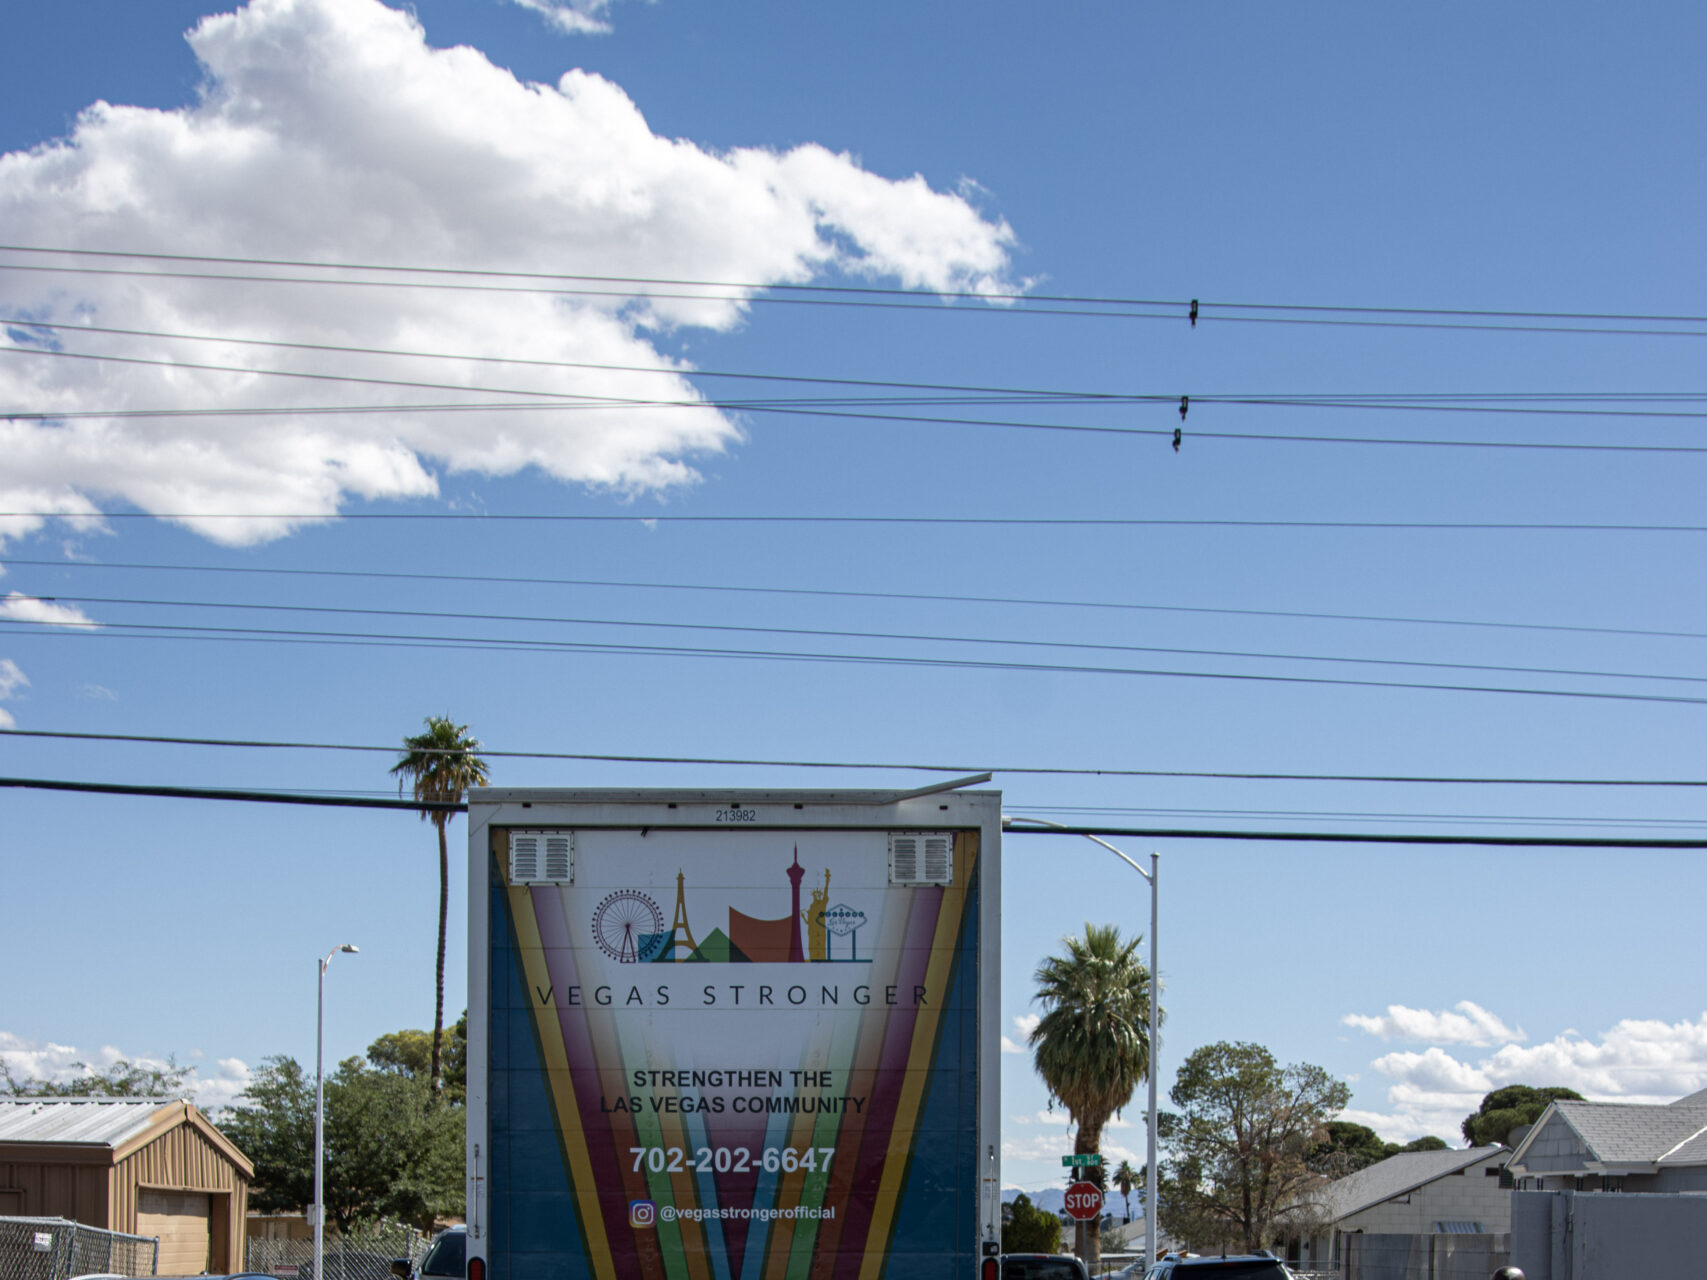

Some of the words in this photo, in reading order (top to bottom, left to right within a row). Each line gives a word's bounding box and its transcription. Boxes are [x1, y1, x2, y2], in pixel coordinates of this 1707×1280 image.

[715, 809, 756, 821] 213982
[535, 985, 670, 1006] VEGAS
[703, 985, 928, 1006] STRONGER
[633, 1070, 782, 1087] STRENGTHEN
[789, 1070, 832, 1087] THE
[600, 1096, 643, 1113] LAS
[649, 1096, 725, 1113] VEGAS
[732, 1096, 867, 1113] COMMUNITY
[629, 1147, 836, 1173] 702-202-6647
[1066, 1193, 1100, 1209] STOP
[660, 1206, 835, 1222] @vegasstrongerofficial
